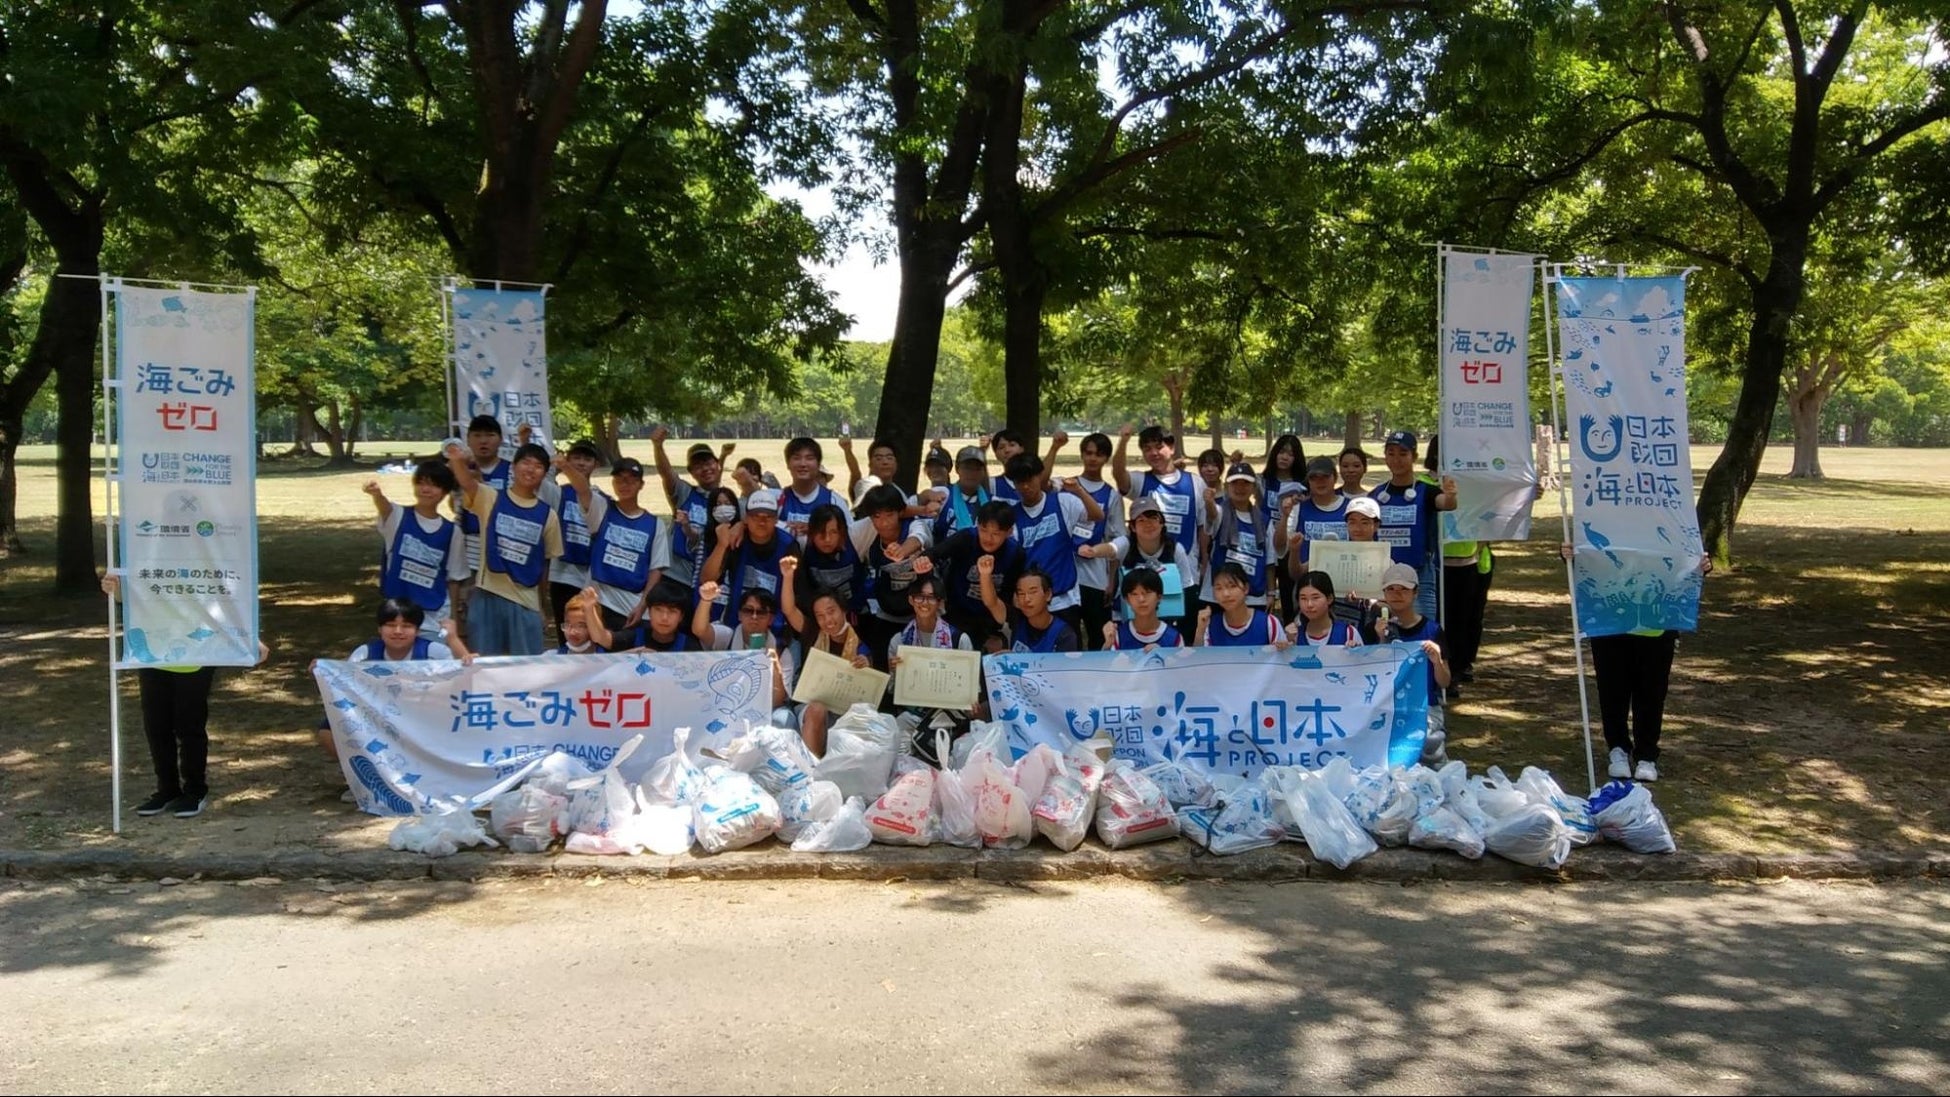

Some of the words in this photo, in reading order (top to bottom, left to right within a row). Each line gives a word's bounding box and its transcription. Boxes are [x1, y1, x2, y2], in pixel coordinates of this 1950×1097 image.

[1450, 328, 1517, 355] 海ごみ
[136, 363, 235, 396] 海ごみ
[1460, 360, 1501, 384] ゼロ
[504, 392, 541, 408] 日本
[156, 402, 217, 430] ゼロ
[1626, 416, 1676, 438] 日本
[182, 453, 232, 463] CHANGE
[205, 470, 232, 479] BLUE
[1583, 467, 1680, 506] 海と日本
[1625, 496, 1682, 509] PROJECT
[139, 568, 241, 580] 未来の海のために、
[150, 583, 232, 595] 今できることを。
[450, 690, 651, 732] 海ごみゼロ
[1103, 705, 1141, 724] 日本
[1152, 691, 1346, 768] 海と日本
